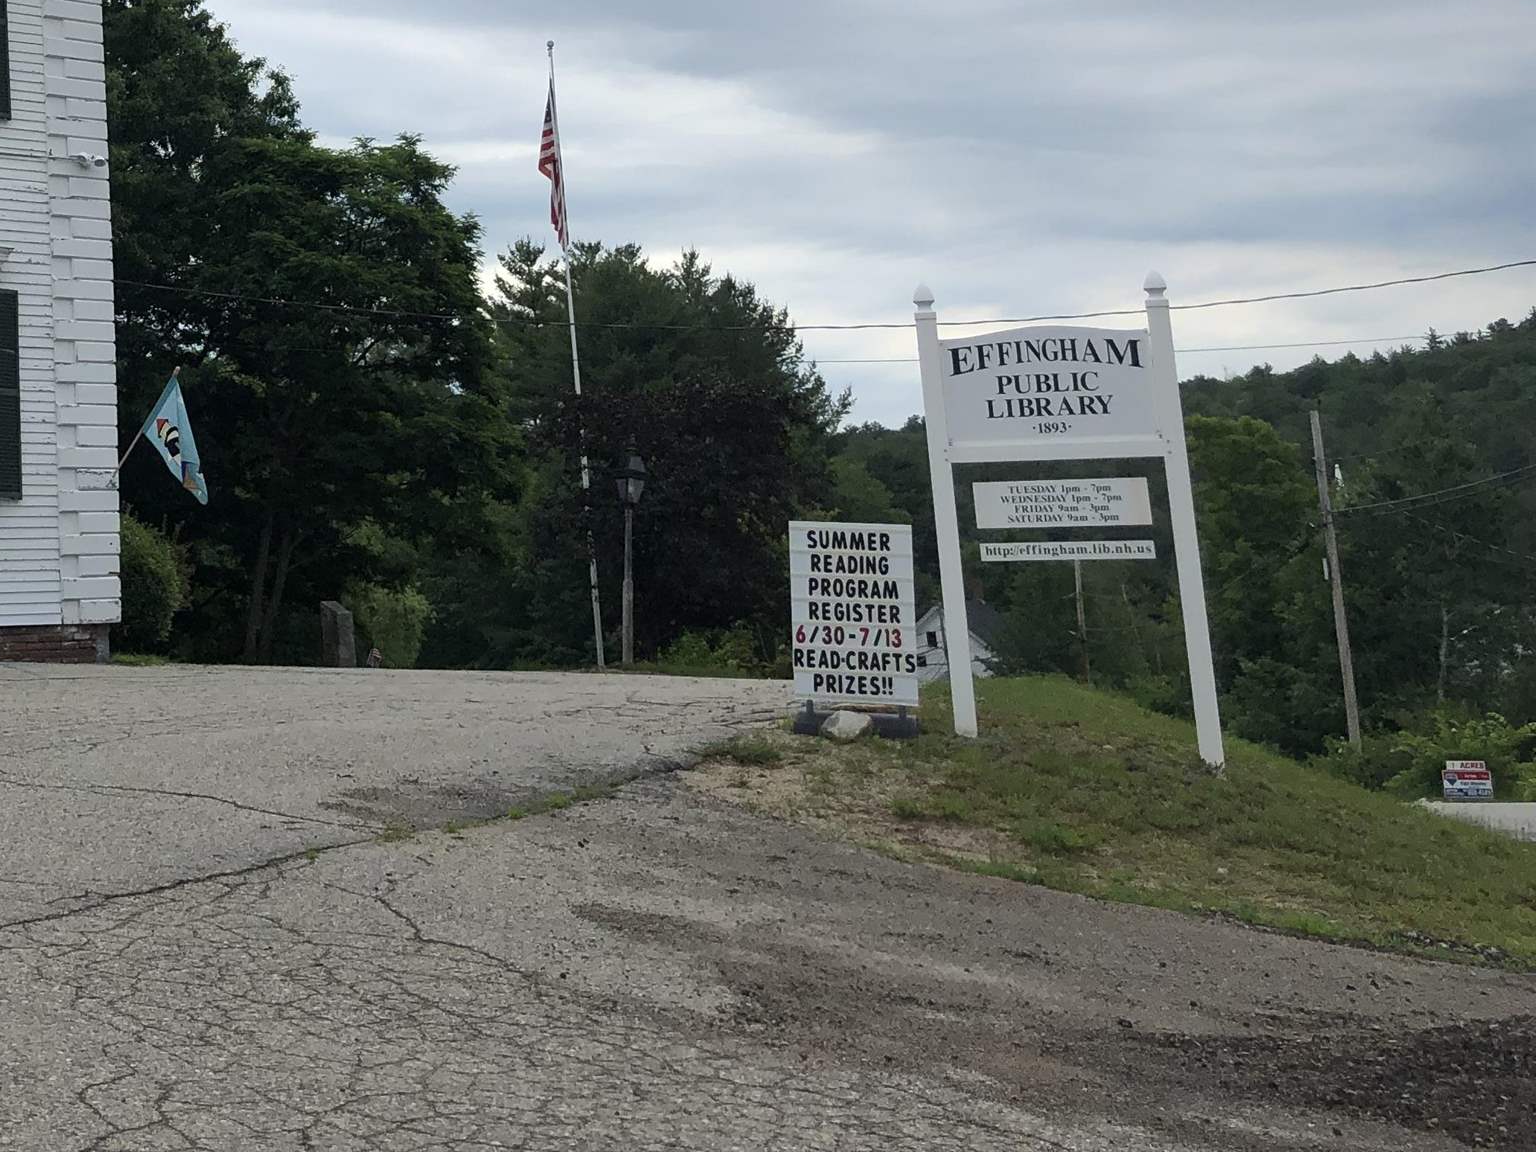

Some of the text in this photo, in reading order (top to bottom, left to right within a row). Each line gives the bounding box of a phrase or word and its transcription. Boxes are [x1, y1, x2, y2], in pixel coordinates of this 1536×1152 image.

[948, 337, 1145, 377] EFFINGHAM
[995, 371, 1100, 394] PUBLIC
[985, 395, 1113, 419] LIBRARY
[1000, 494, 1066, 503] WEDNESDAY
[1071, 494, 1091, 504] 1pm
[1008, 485, 1056, 494] TUESDAY
[1061, 485, 1081, 494] 1pm
[1091, 483, 1112, 494] 7pm
[1007, 513, 1063, 523] SATURDAY
[1098, 512, 1120, 523] 3pm
[1014, 504, 1055, 513] FRIDAY
[1089, 503, 1110, 513] 3pm
[807, 530, 890, 551] SUMMER
[811, 554, 889, 575] READING
[808, 578, 899, 599] PROGRAM
[809, 602, 901, 624] REGISTER
[814, 674, 894, 695] PRIZES!!
